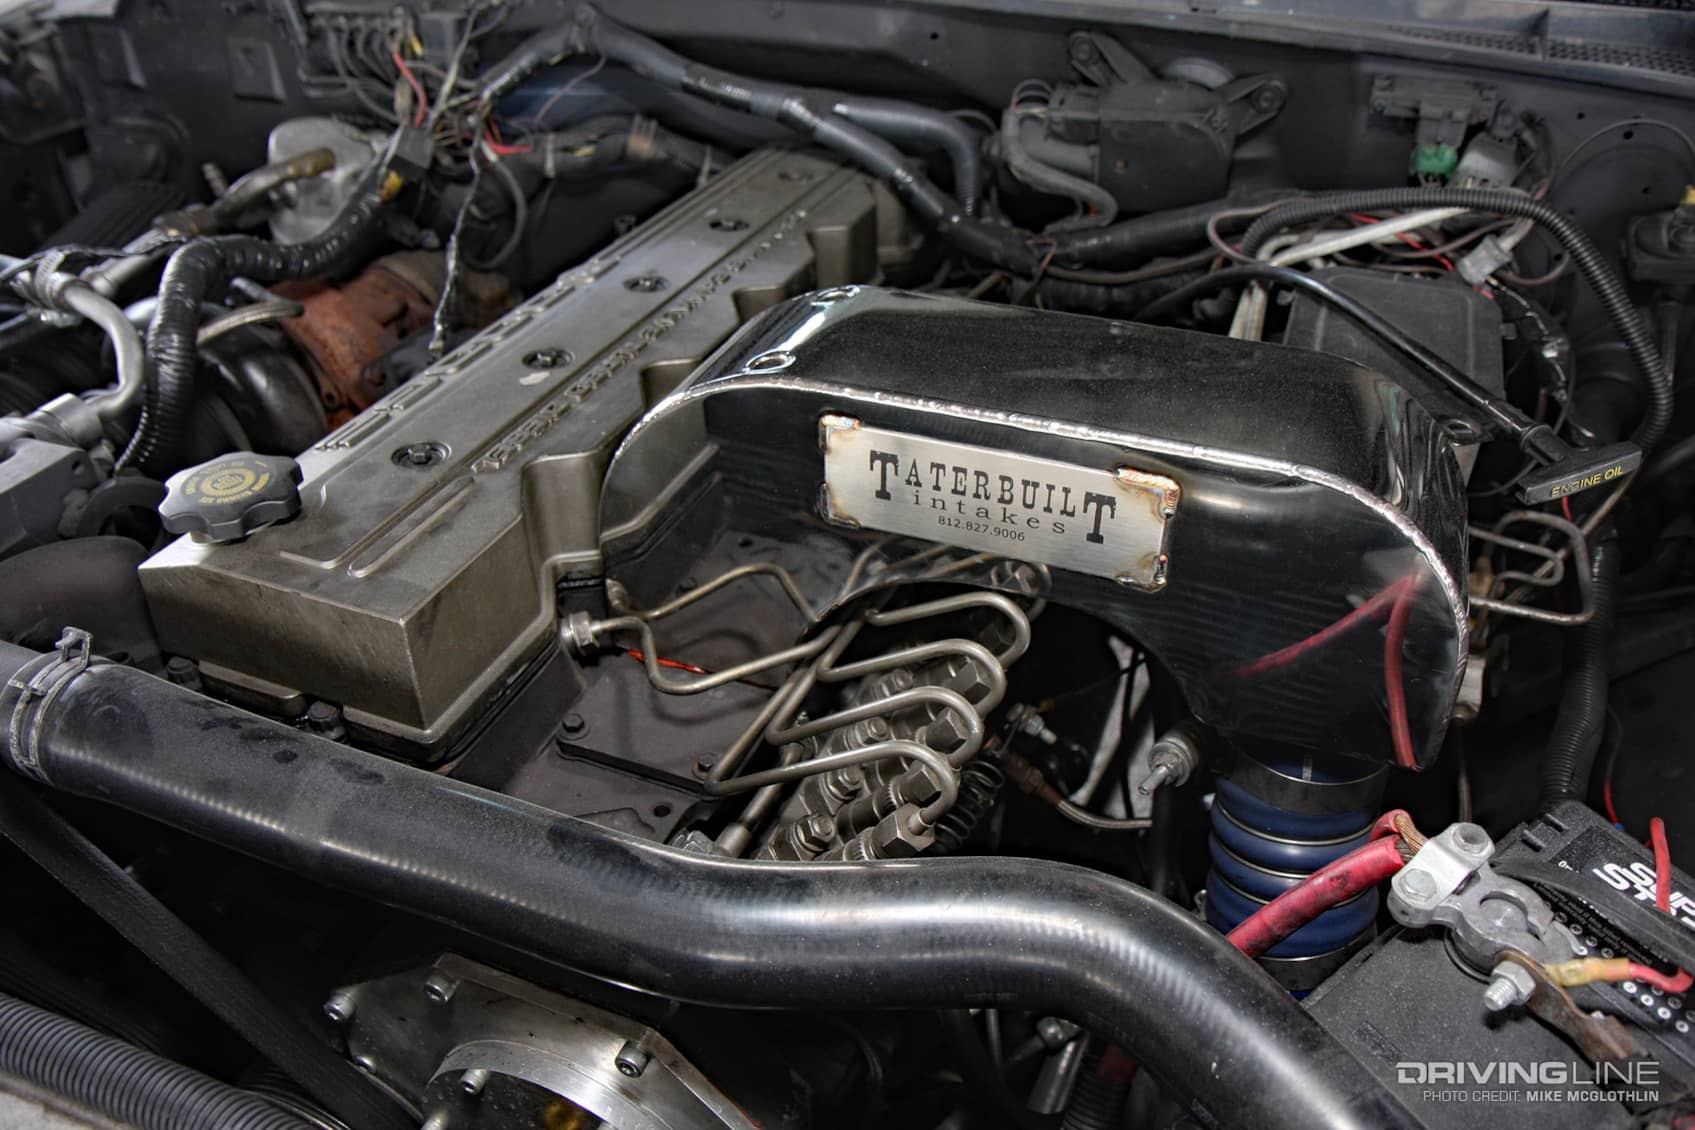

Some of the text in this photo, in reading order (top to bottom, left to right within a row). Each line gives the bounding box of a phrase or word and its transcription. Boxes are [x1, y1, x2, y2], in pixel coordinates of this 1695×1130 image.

[869, 450, 1116, 544] TATERBUILT
[1551, 466, 1623, 497] ENGINE OIL
[912, 490, 1066, 534] intakes
[938, 515, 1025, 541] 812.827.9006
